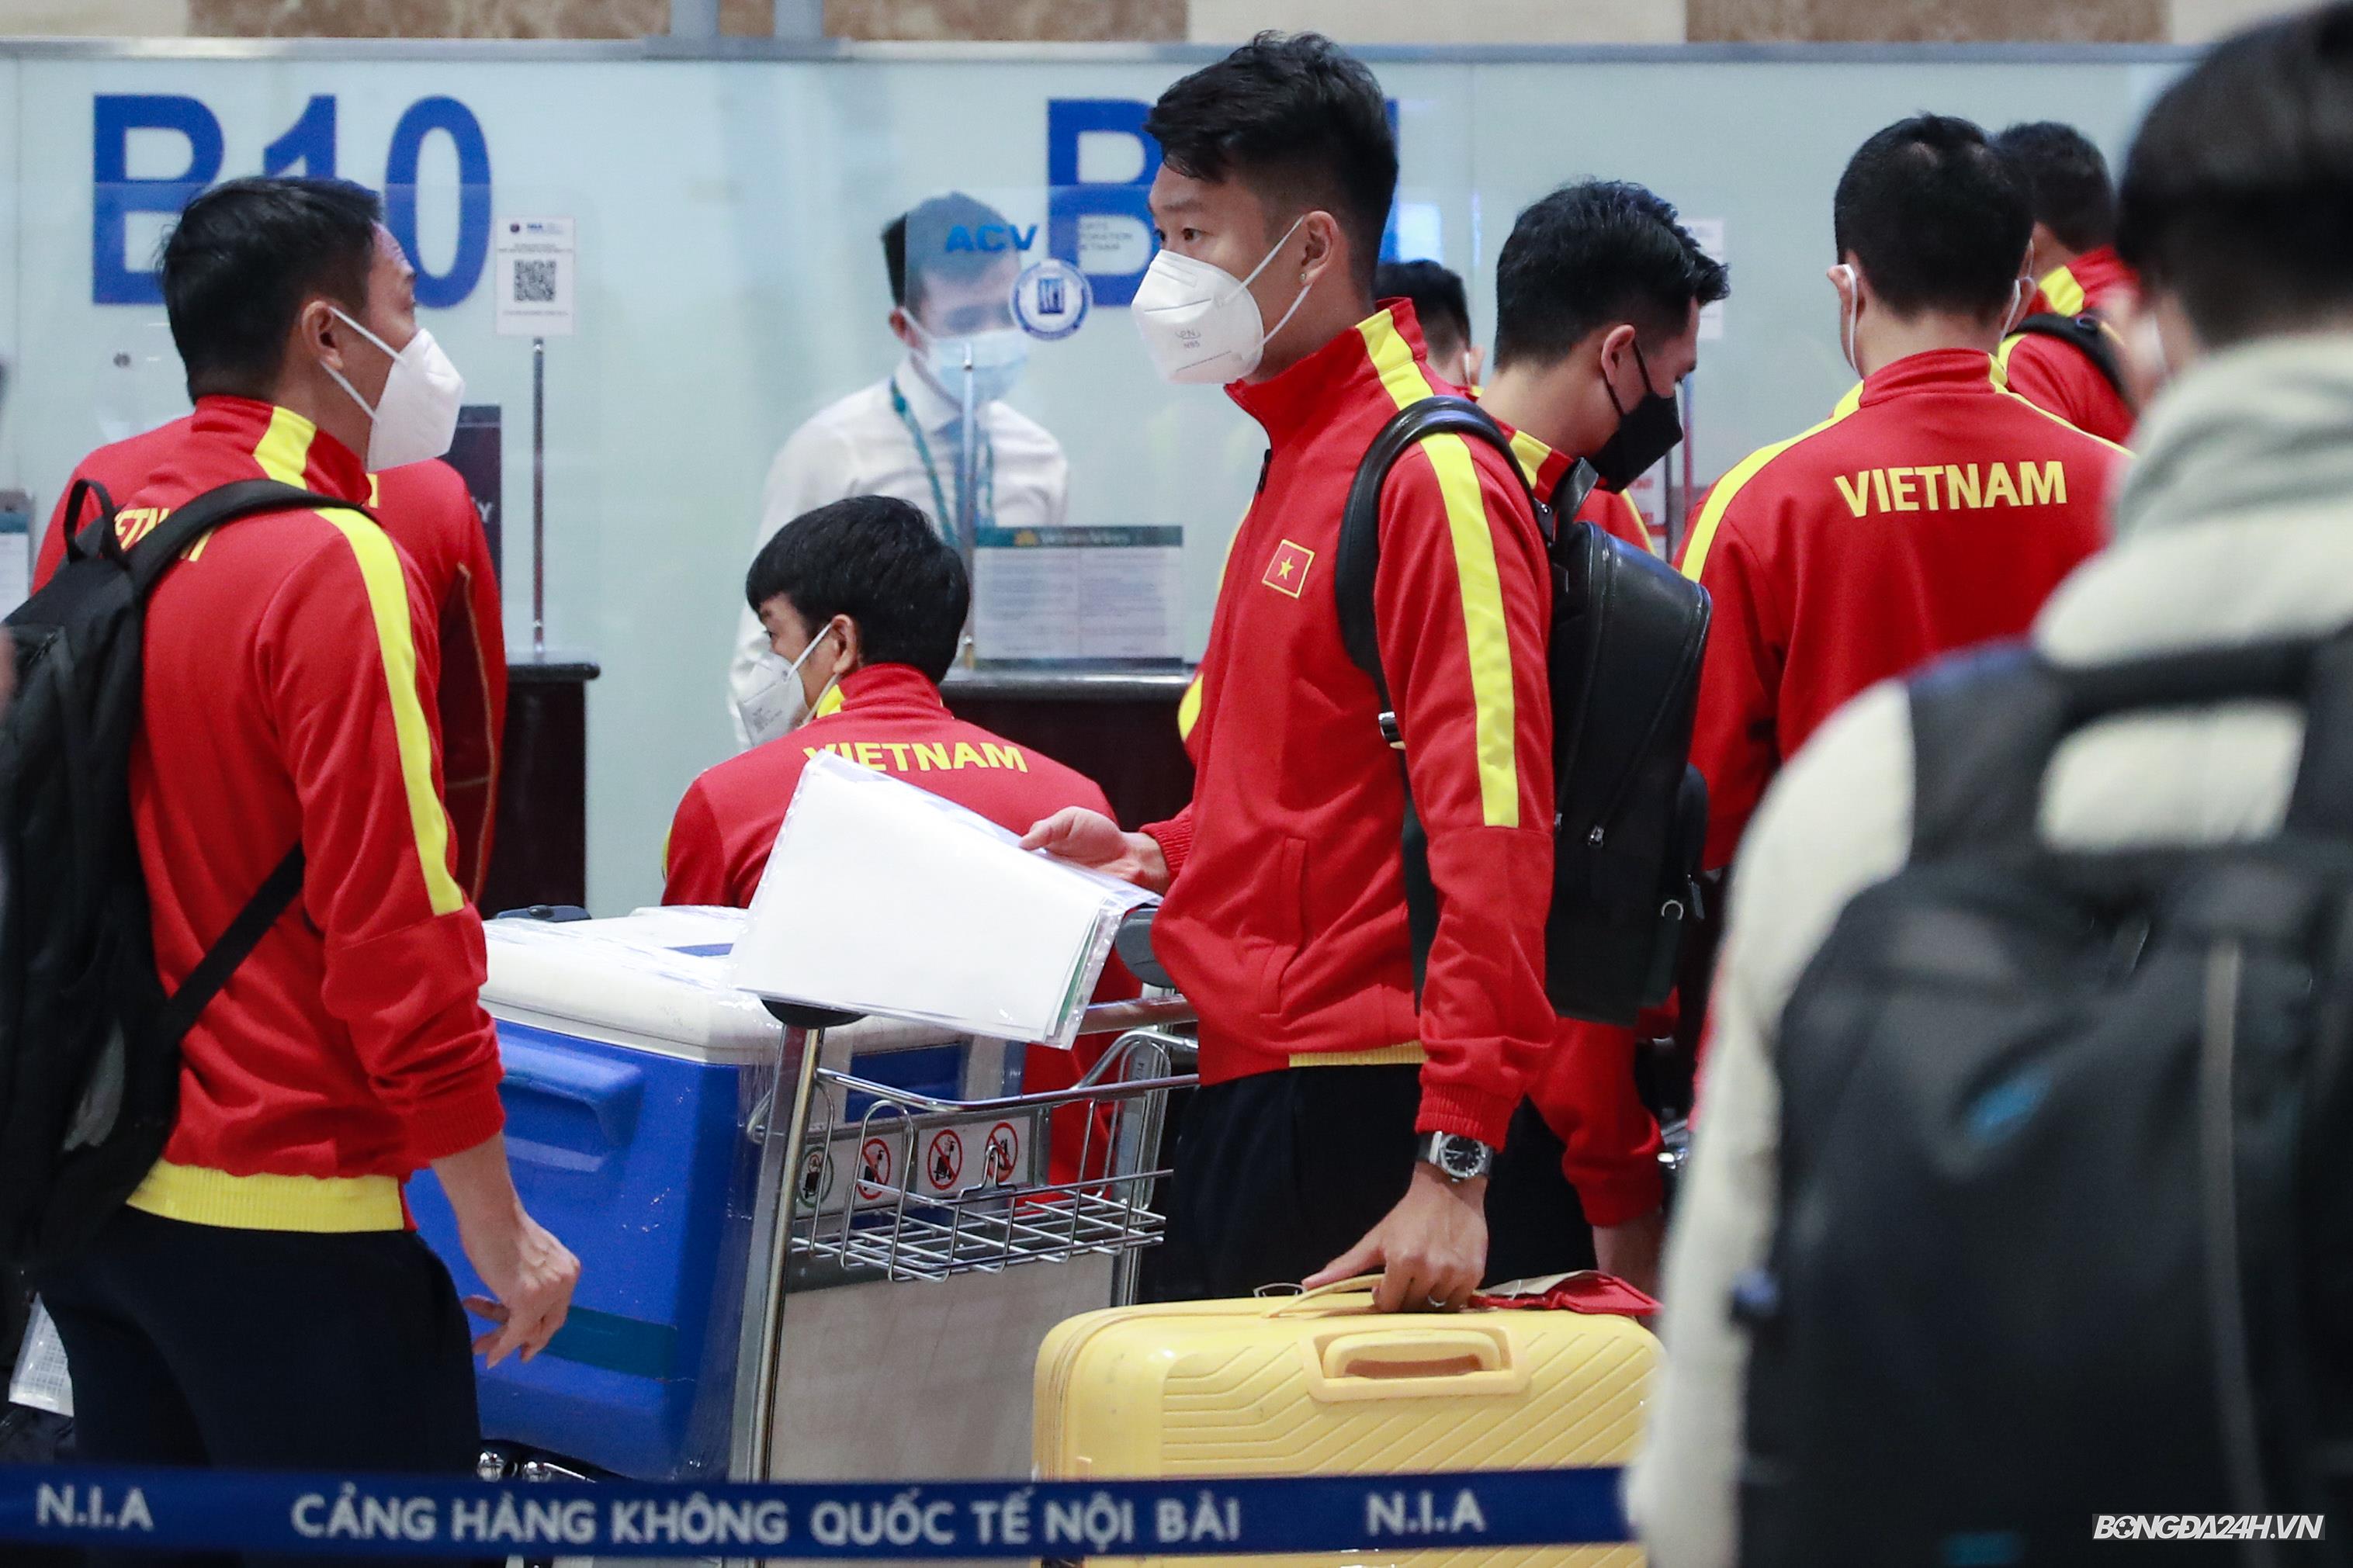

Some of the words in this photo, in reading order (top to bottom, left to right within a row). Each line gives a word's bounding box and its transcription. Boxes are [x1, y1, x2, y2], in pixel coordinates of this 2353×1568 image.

[944, 223, 1038, 253] ACV
[1834, 461, 2067, 517] VIETNAM
[36, 1483, 153, 1531] N.I.A
[290, 1481, 437, 1541] CẢNG
[449, 1490, 597, 1545] HÀNG
[611, 1491, 788, 1545] KHÔNG
[809, 1487, 955, 1546] QUỐC
[970, 1486, 1035, 1545] TẾ
[1044, 1490, 1134, 1552] NỘI
[1156, 1489, 1241, 1543] BÀI
[1367, 1487, 1485, 1535] N.I.A
